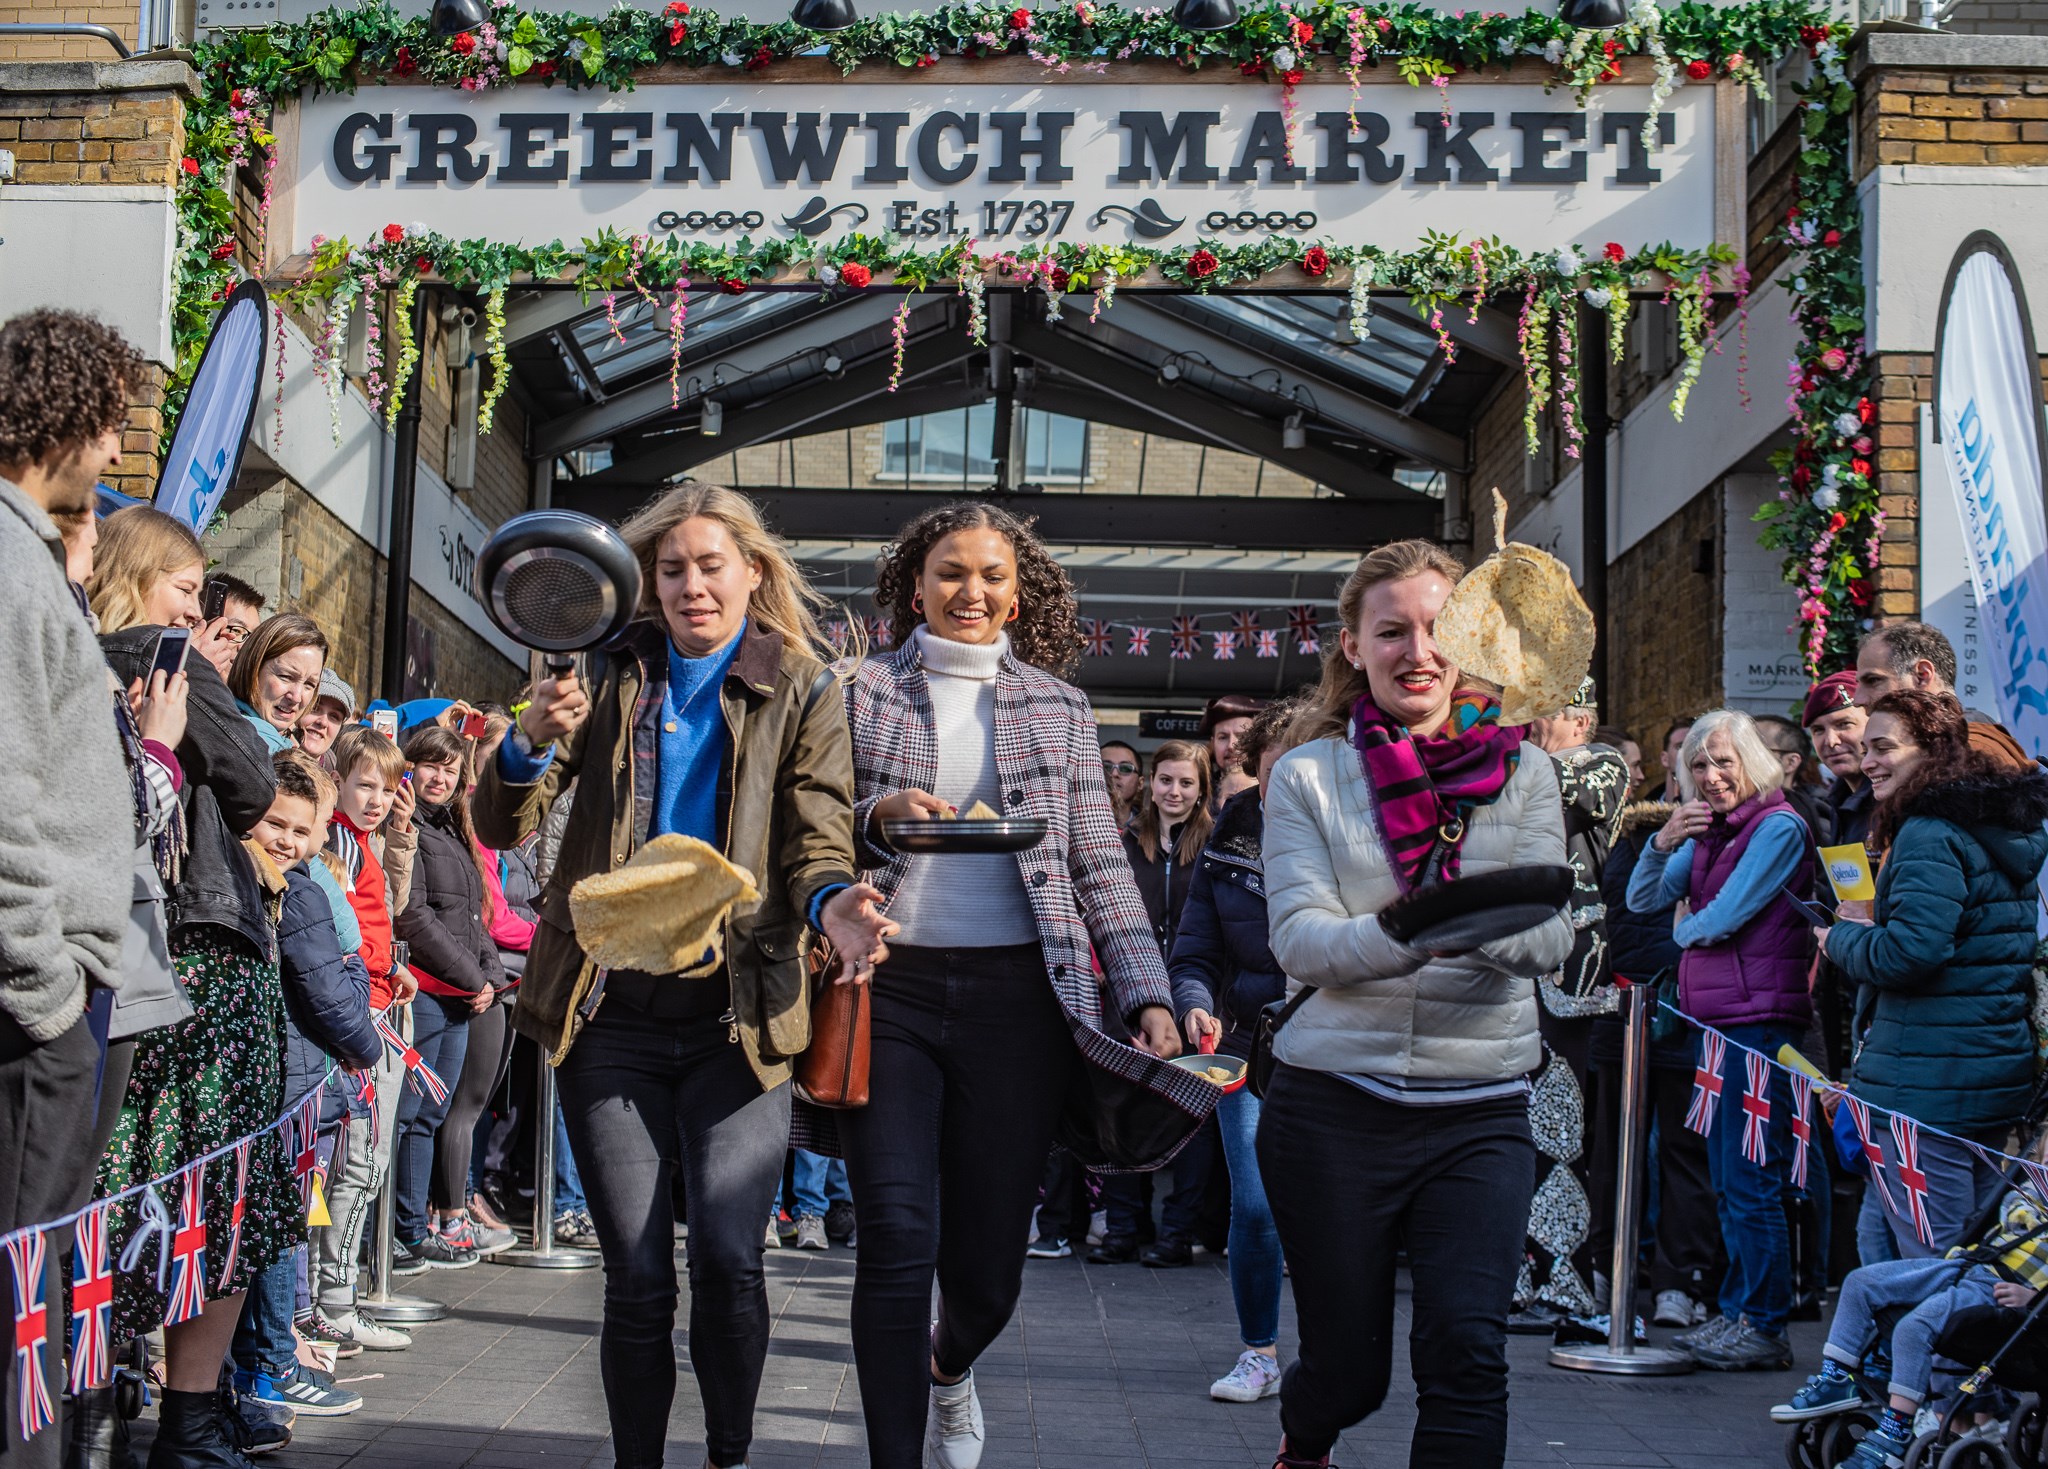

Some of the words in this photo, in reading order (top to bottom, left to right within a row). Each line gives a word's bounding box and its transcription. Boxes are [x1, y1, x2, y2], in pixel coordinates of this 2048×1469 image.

[334, 112, 1074, 183] GREENWICH
[1119, 110, 1676, 182] MARKET
[892, 200, 968, 235] Est.
[983, 200, 1074, 236] 1737
[1964, 683, 1978, 697] &
[1155, 718, 1200, 731] COFFEE
[1830, 865, 1860, 883] Splenda
